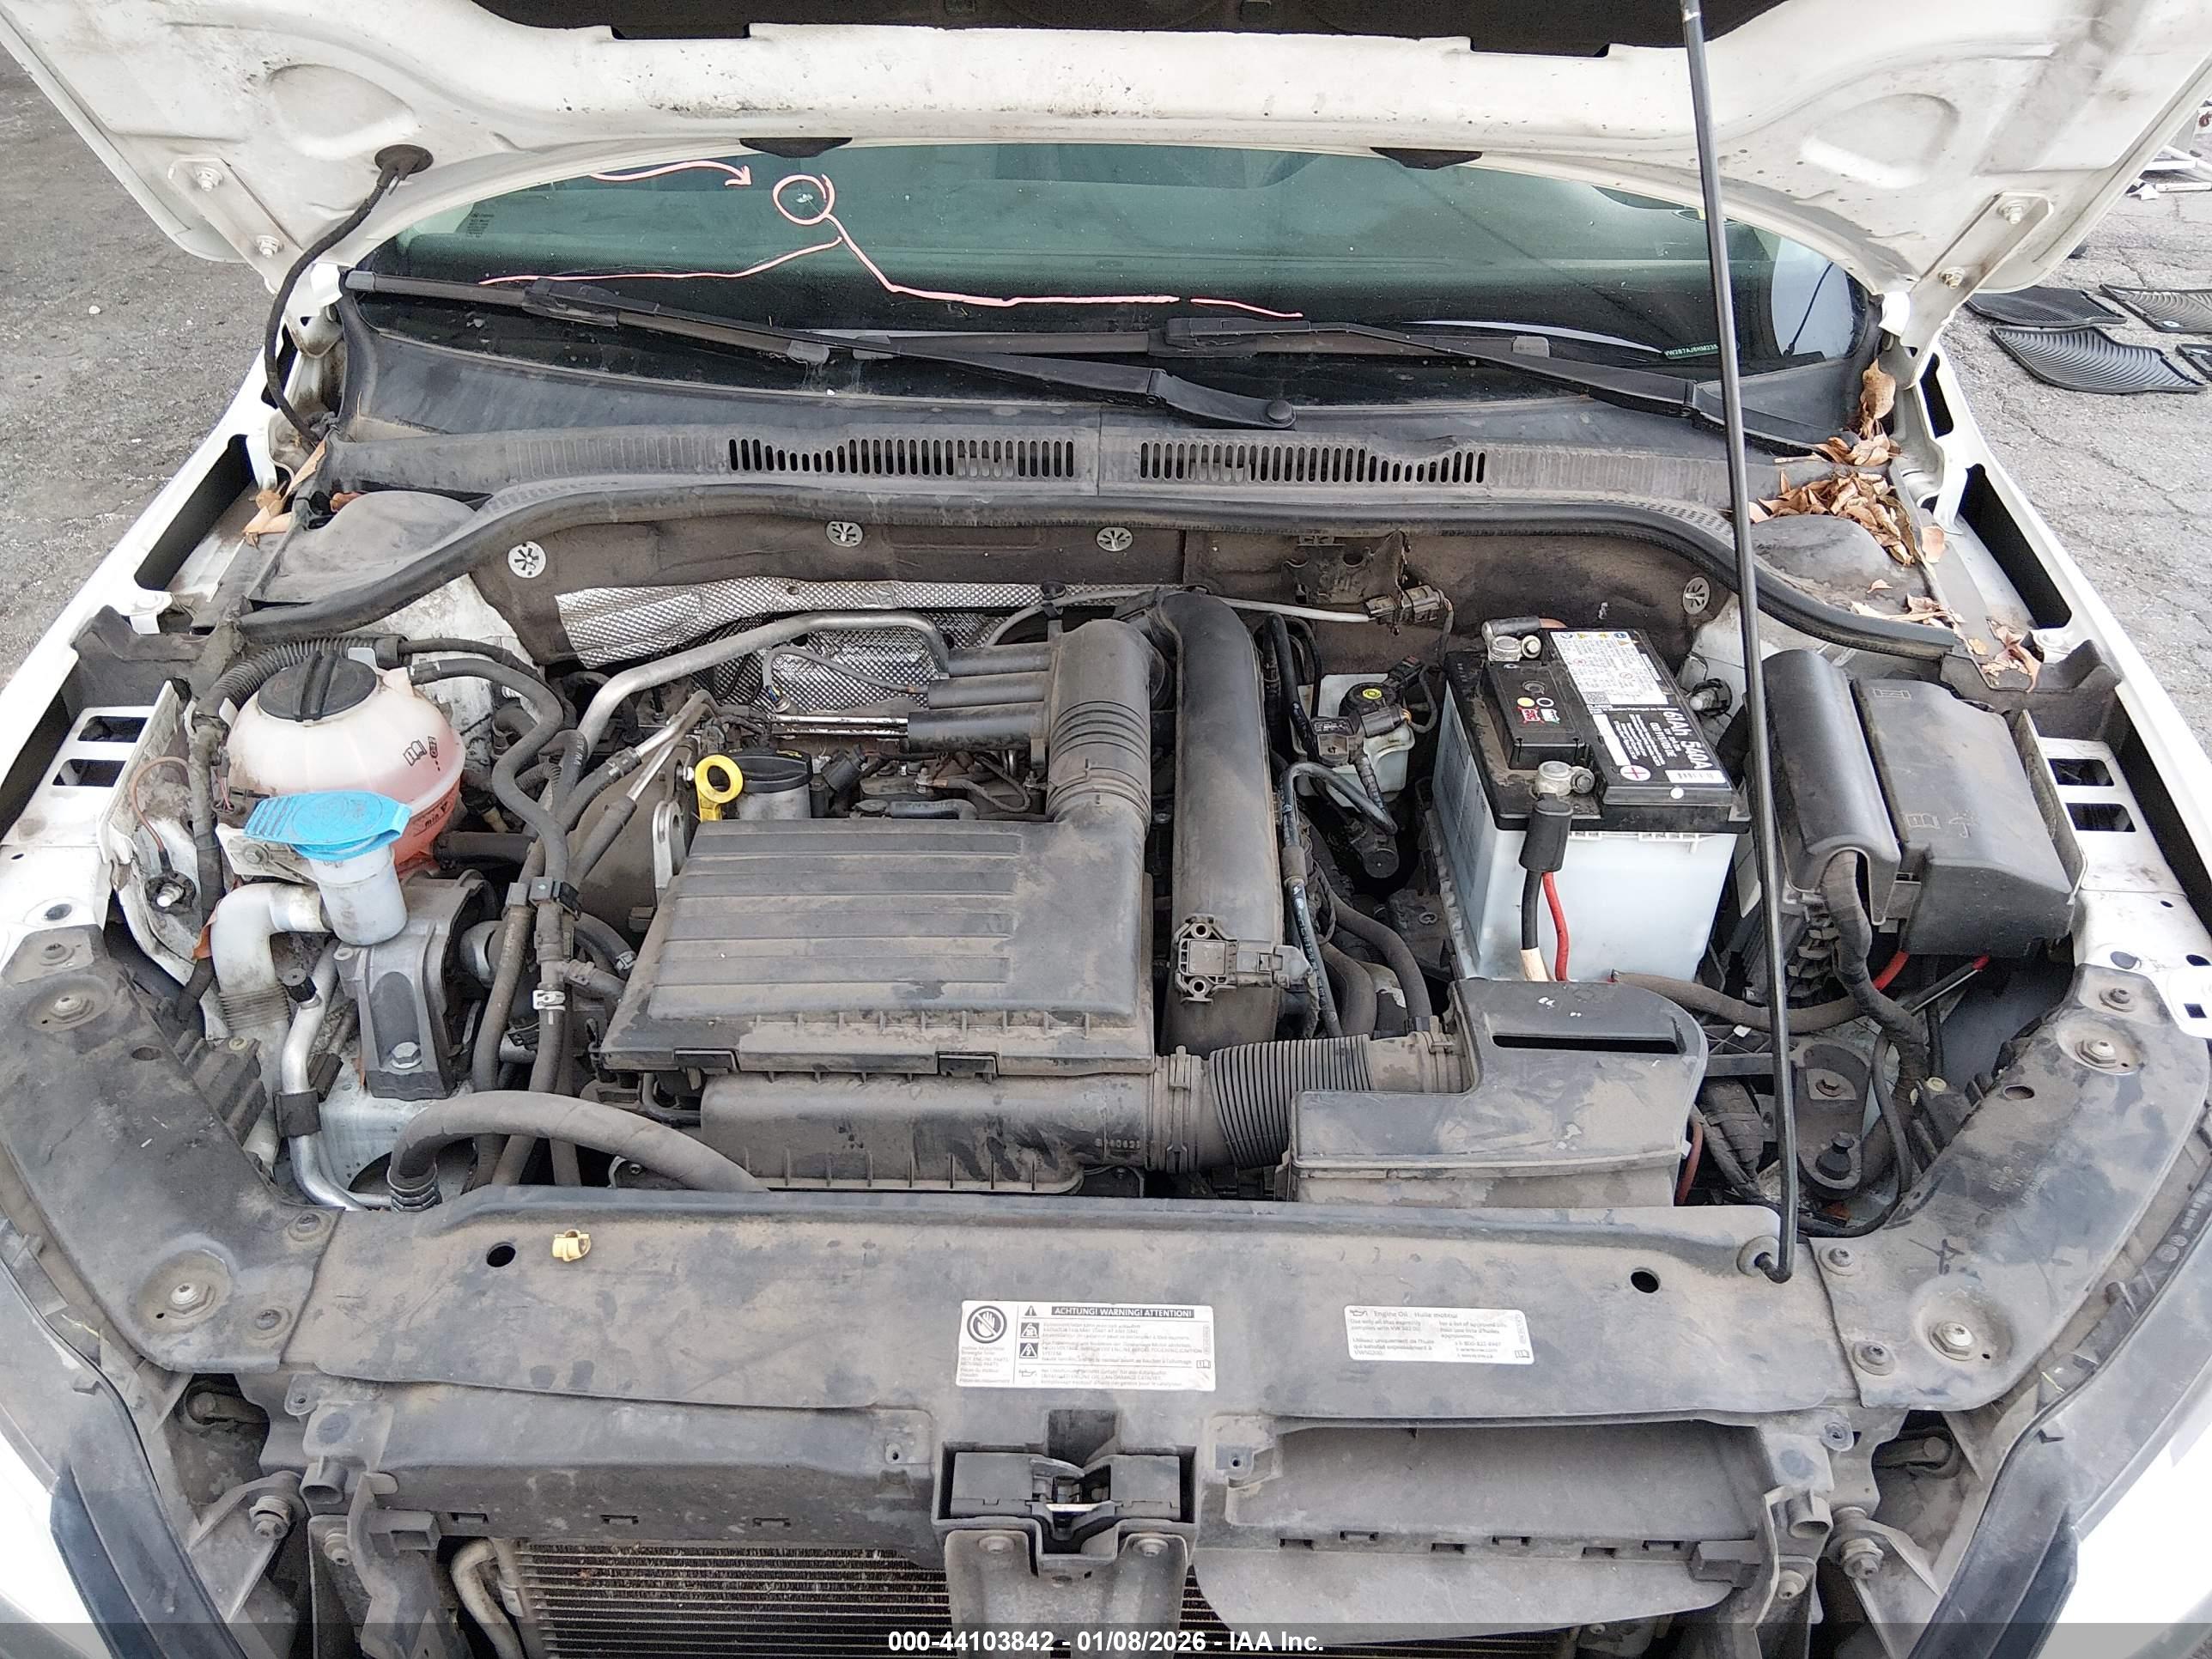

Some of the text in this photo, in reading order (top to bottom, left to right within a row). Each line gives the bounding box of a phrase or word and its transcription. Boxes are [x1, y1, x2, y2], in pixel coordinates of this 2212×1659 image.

[1663, 712, 1692, 735] 61Ah
[1680, 741, 1713, 769] 540A
[425, 813, 439, 828] min
